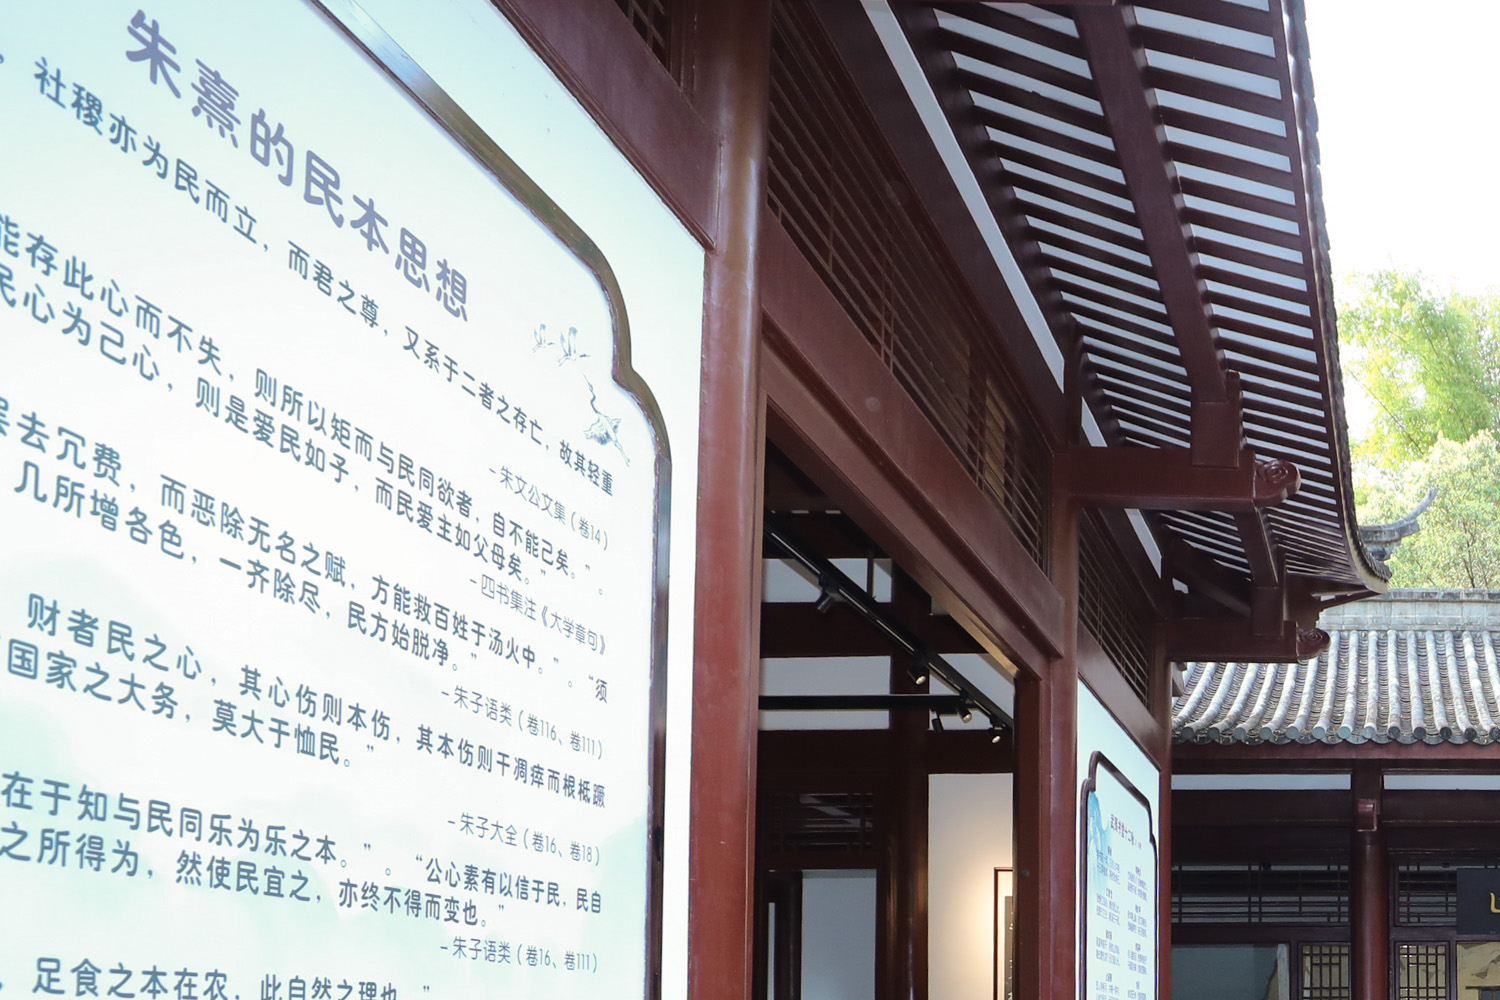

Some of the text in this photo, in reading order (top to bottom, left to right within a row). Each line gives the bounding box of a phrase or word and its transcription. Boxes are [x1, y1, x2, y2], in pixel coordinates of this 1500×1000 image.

[126, 9, 469, 322] 朱熹的民本思想
